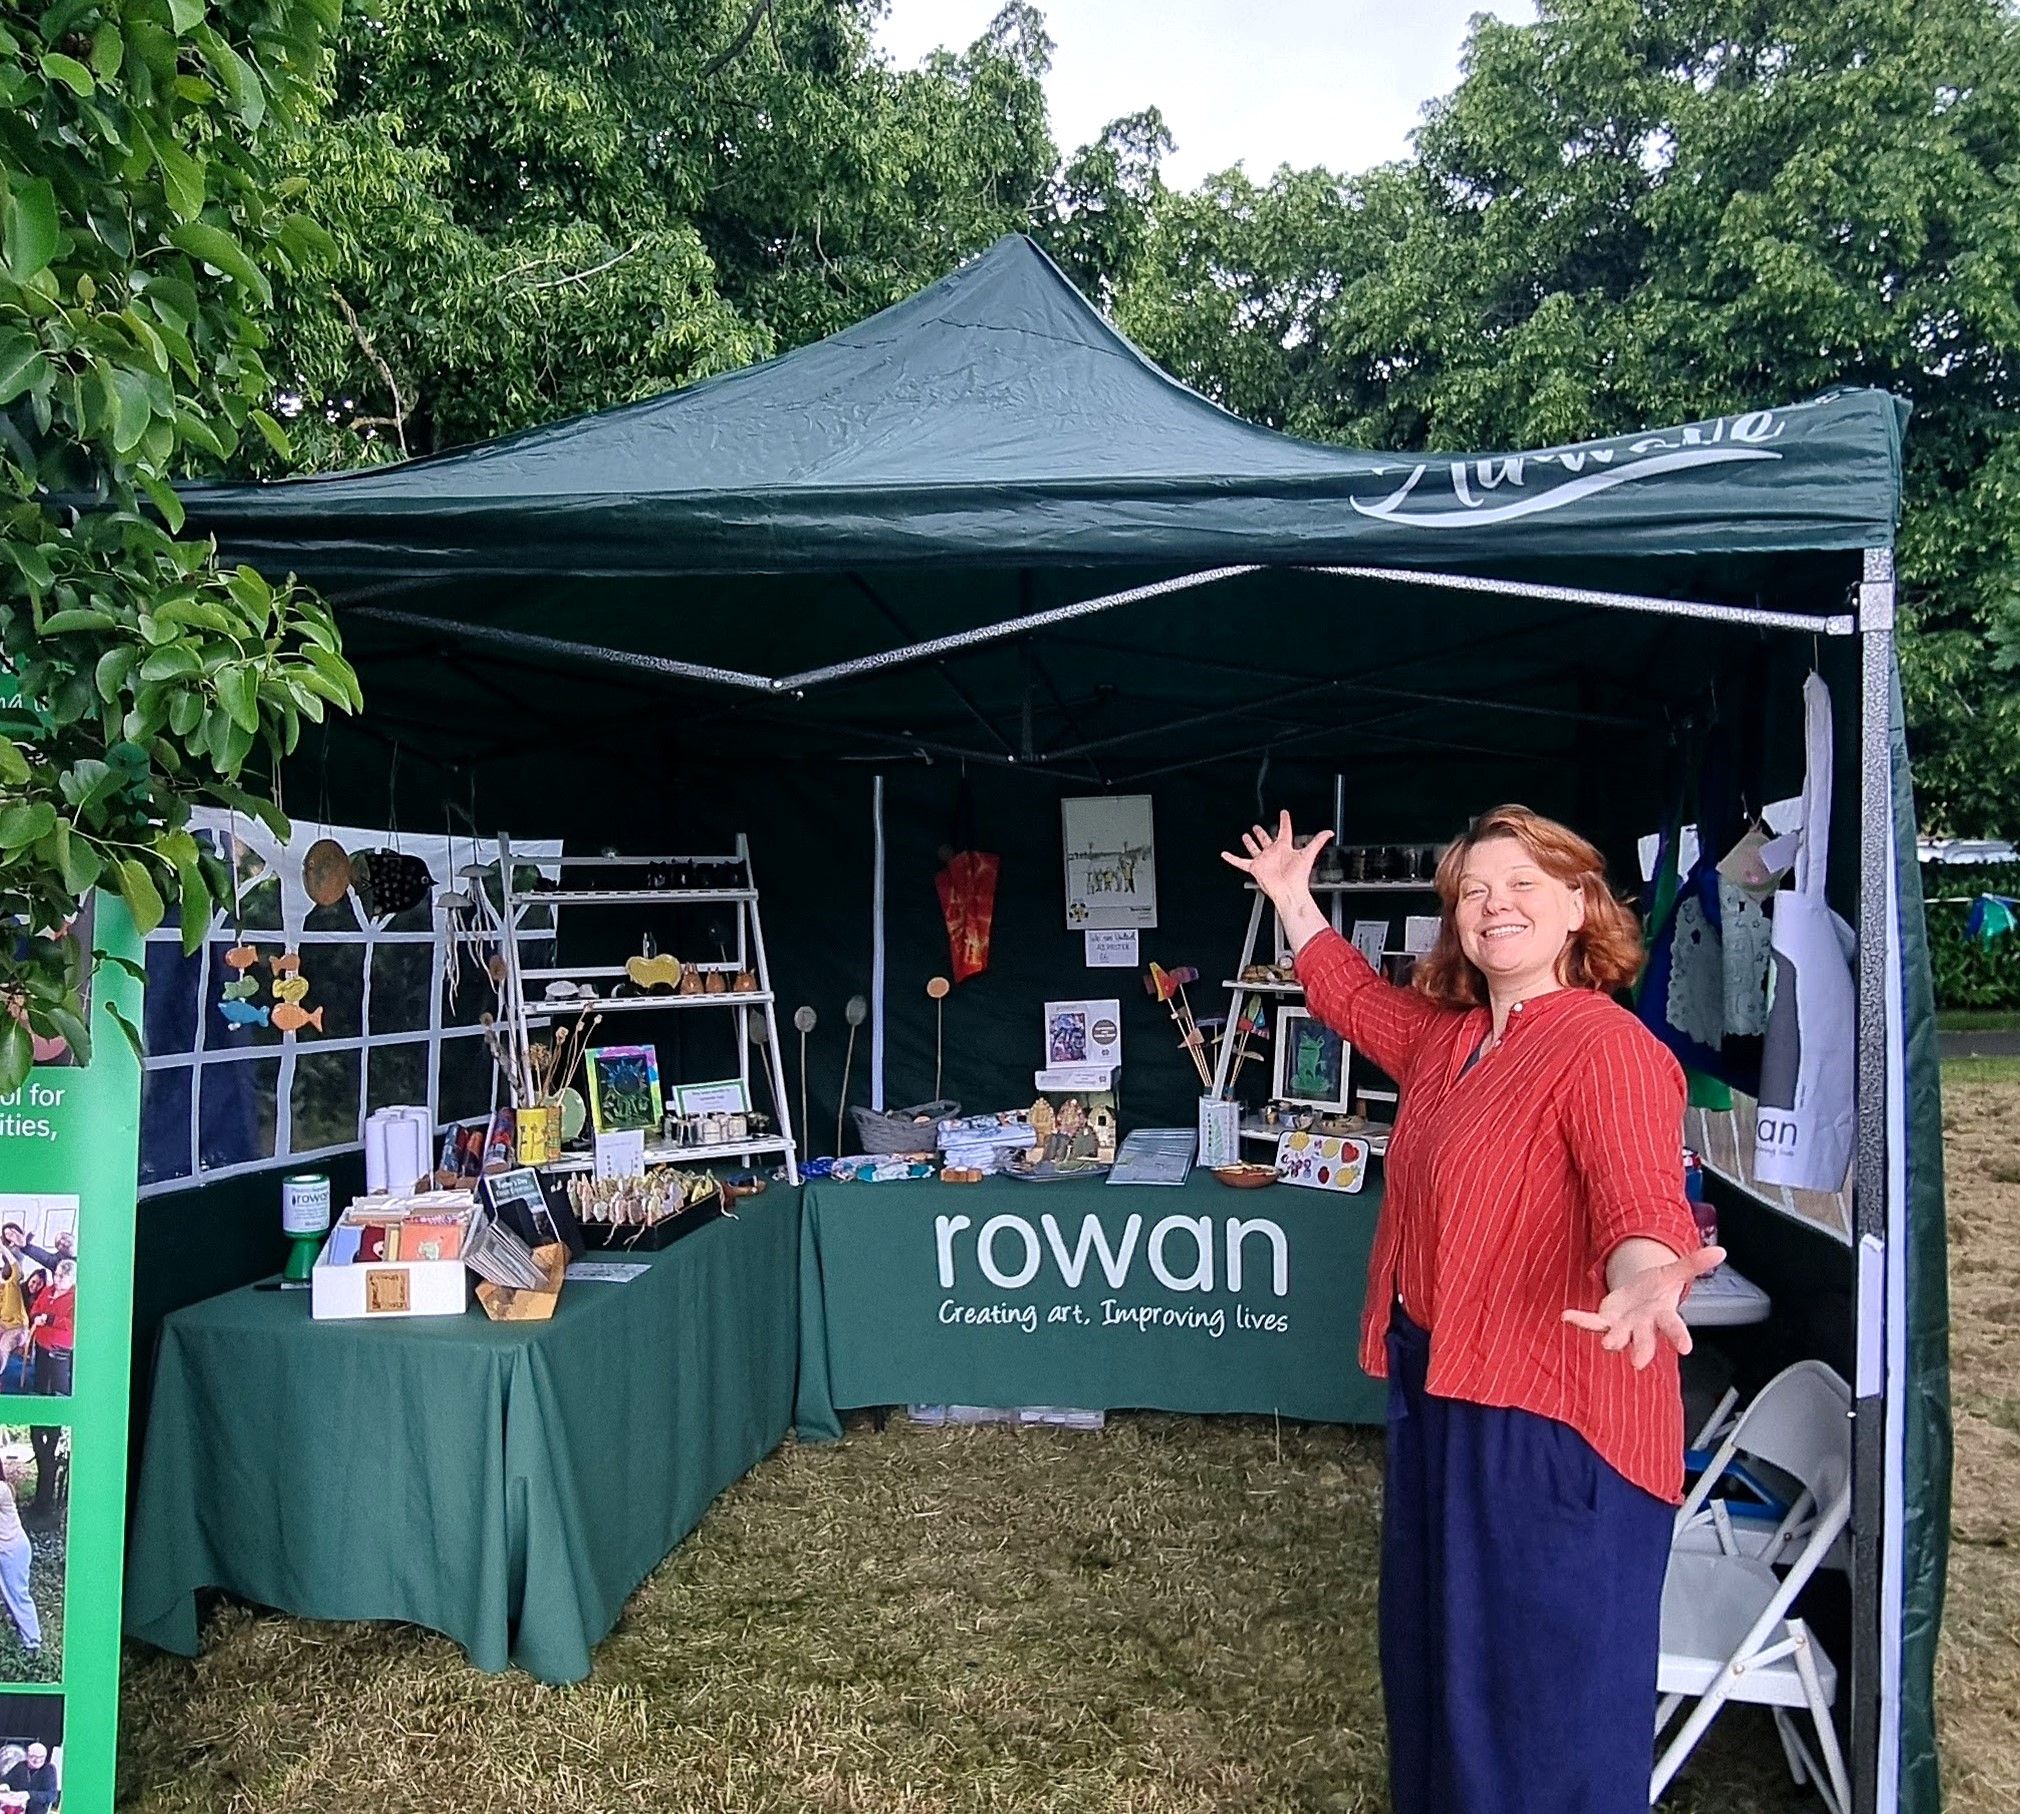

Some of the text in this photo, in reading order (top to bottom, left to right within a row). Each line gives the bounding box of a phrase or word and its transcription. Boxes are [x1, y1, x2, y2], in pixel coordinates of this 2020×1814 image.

[29, 1082, 66, 1107] for
[1759, 1119, 1797, 1146] an
[934, 1212, 1290, 1297] rowan
[938, 1298, 1289, 1338] Creating art, Improving lives
